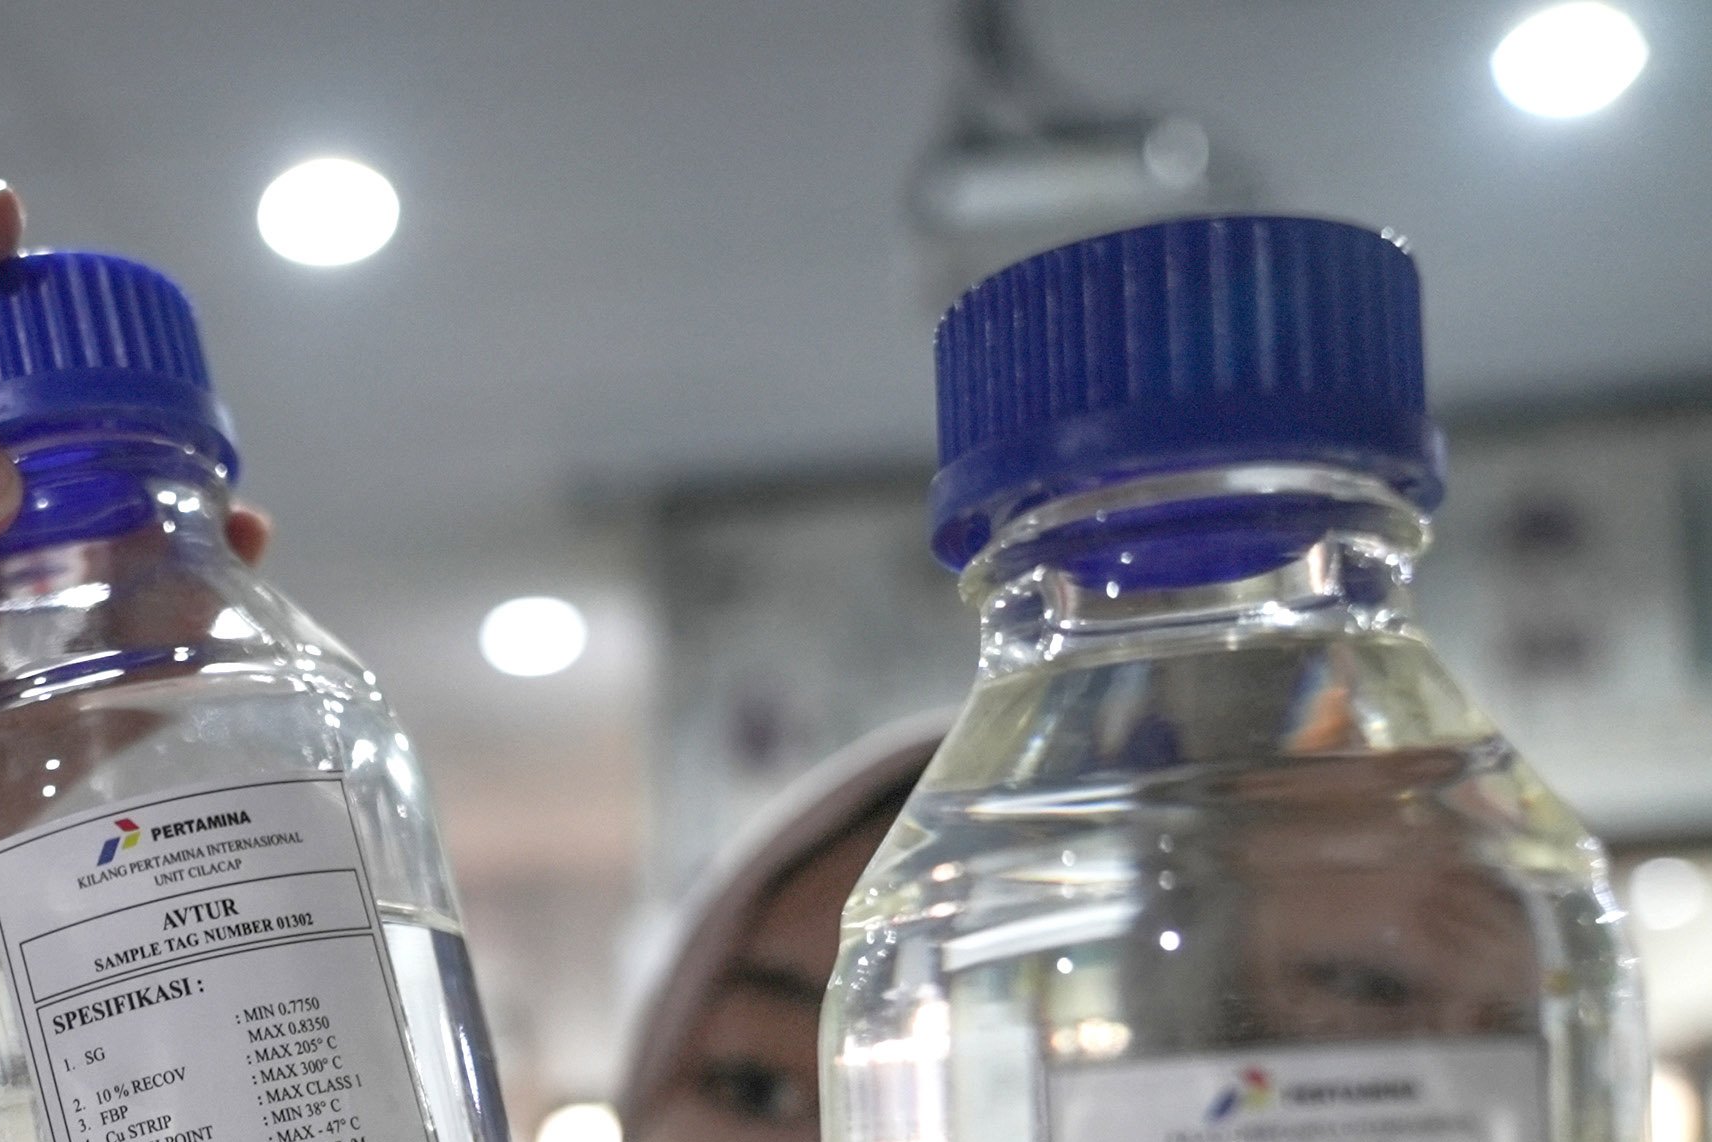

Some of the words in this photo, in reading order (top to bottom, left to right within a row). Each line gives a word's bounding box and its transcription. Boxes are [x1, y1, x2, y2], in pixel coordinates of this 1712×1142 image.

[150, 810, 251, 841] PERTAMINA
[77, 864, 128, 889] KILANG
[128, 846, 205, 874] PERTAMINA
[205, 831, 303, 856] INTERNASIONAL
[153, 868, 184, 886] UNIT
[187, 858, 242, 878] CILACAP
[94, 941, 161, 972] SAMPLE
[163, 932, 199, 952] TAG
[203, 918, 274, 943] NUMBER
[276, 912, 313, 929] 01302
[163, 898, 239, 930] AVTUR
[52, 977, 192, 1034] SPESIFIKASI
[63, 1058, 75, 1072] 1.
[84, 1047, 105, 1065] SG
[243, 1003, 275, 1022] MIN
[277, 996, 320, 1016] 0.7750
[247, 1023, 286, 1043] MAX
[287, 1015, 329, 1035] 0.8350
[72, 1098, 86, 1113] 2.
[96, 1088, 112, 1105] 10
[113, 1083, 129, 1099] %
[131, 1066, 185, 1094] RECOV
[254, 1043, 293, 1063] MAX
[294, 1037, 323, 1055] 205°
[326, 1035, 337, 1049] C
[78, 1118, 91, 1133] 3.
[99, 1104, 128, 1125] FBP
[259, 1063, 298, 1083] MAX
[300, 1057, 328, 1075] 300°
[331, 1055, 342, 1069] C
[127, 1114, 171, 1139] STRIP
[265, 1083, 304, 1103] MAX
[305, 1074, 352, 1095] CLASS
[354, 1073, 362, 1087] 1
[270, 1105, 302, 1124] MIN
[305, 1100, 326, 1117] 38°
[330, 1098, 341, 1112] C
[326, 1117, 346, 1134] 47°
[349, 1115, 360, 1130] C
